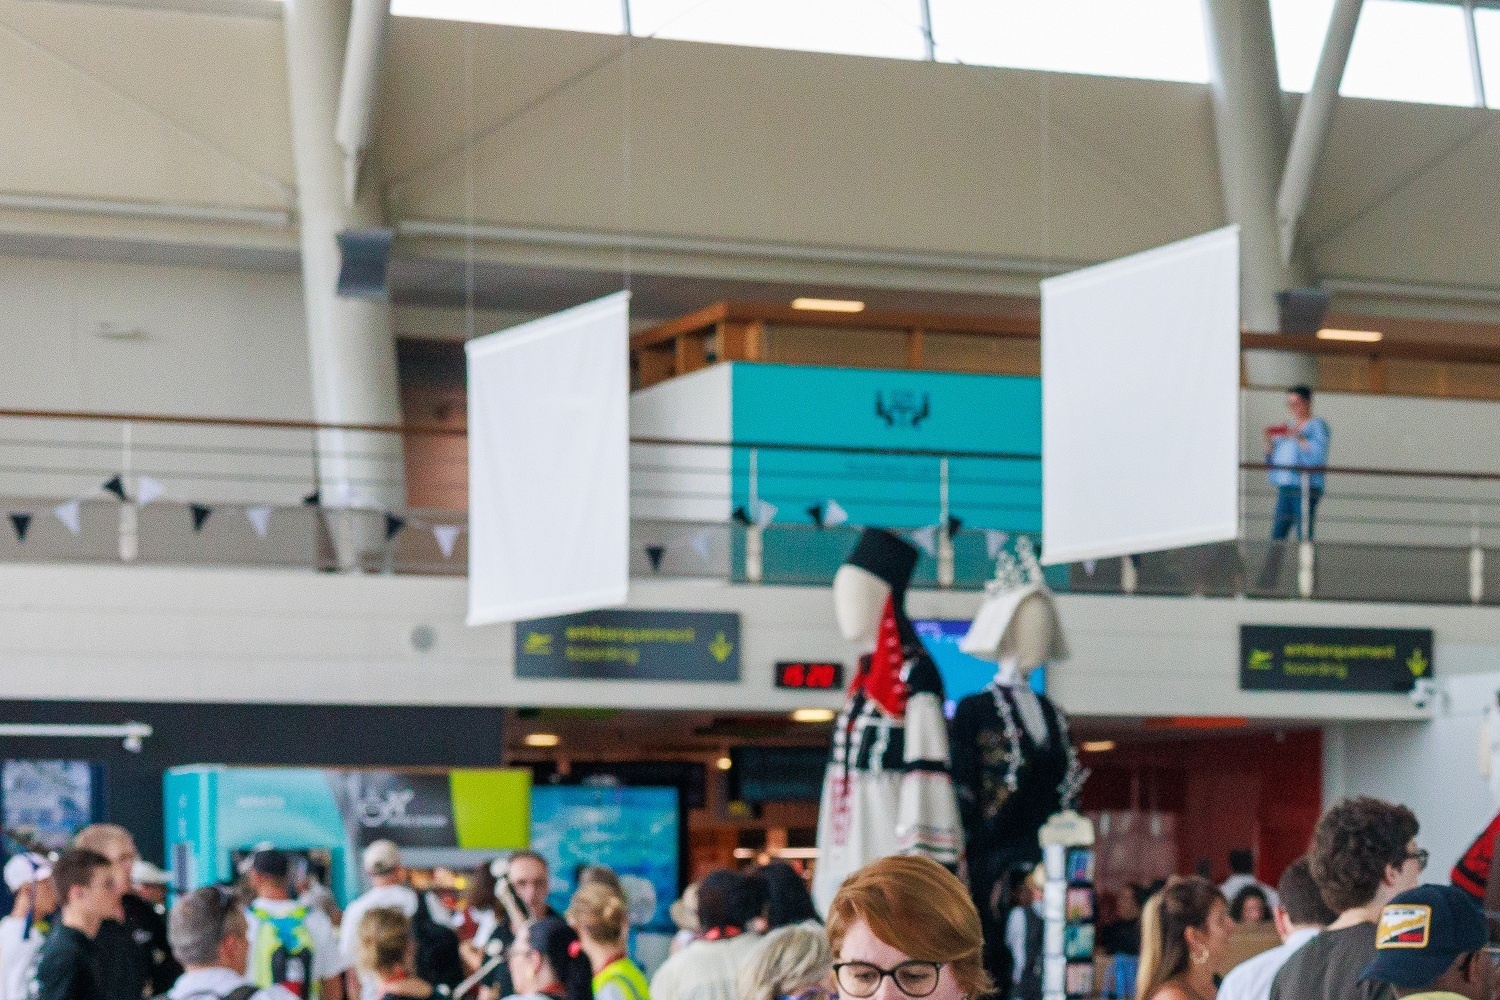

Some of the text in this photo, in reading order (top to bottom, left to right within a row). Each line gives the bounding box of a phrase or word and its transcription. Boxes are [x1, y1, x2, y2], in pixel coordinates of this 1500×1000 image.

[565, 625, 695, 643] embarquement
[565, 645, 640, 665] boarding
[1283, 643, 1397, 660] embarquement
[1282, 661, 1349, 680] boarding
